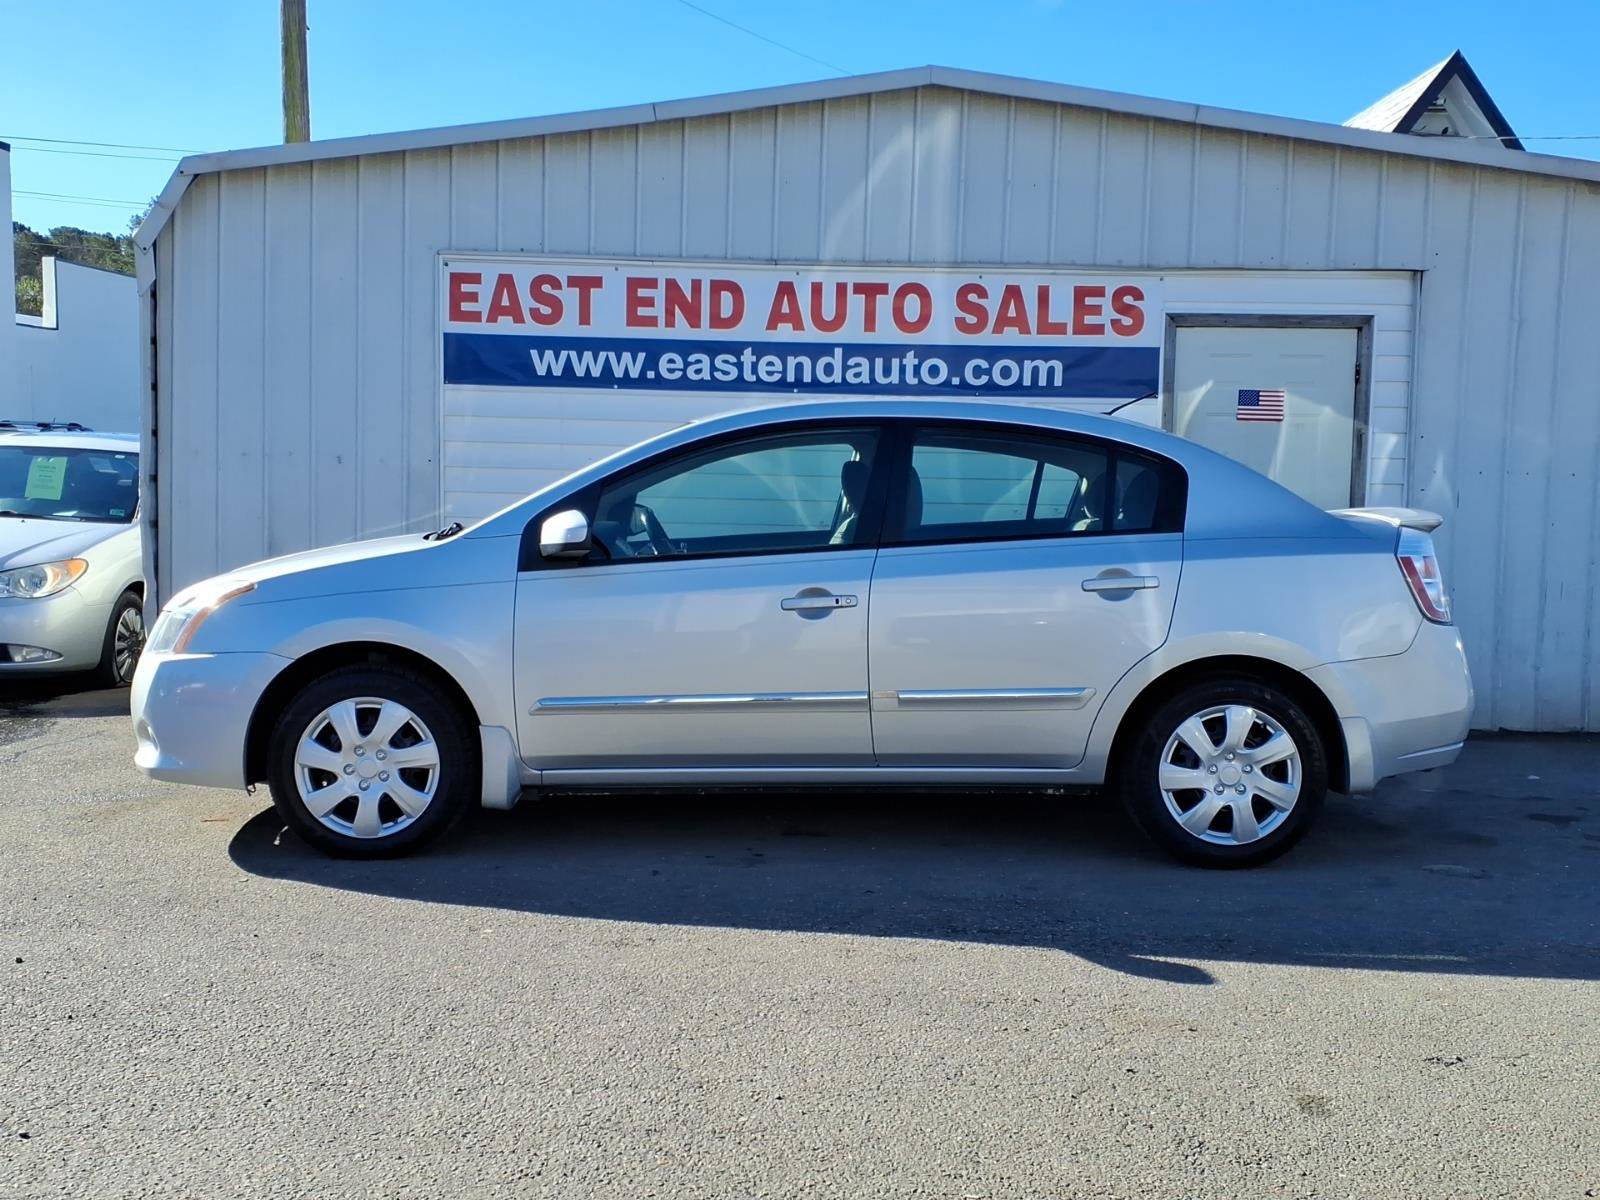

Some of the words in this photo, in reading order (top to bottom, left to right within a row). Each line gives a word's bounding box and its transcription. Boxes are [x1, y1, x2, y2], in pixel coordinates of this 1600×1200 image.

[448, 271, 604, 326] EAST
[625, 276, 746, 330] END
[764, 280, 933, 335] AUTO
[954, 283, 1145, 337] SALES
[529, 346, 1064, 388] www.eastendauto.com
